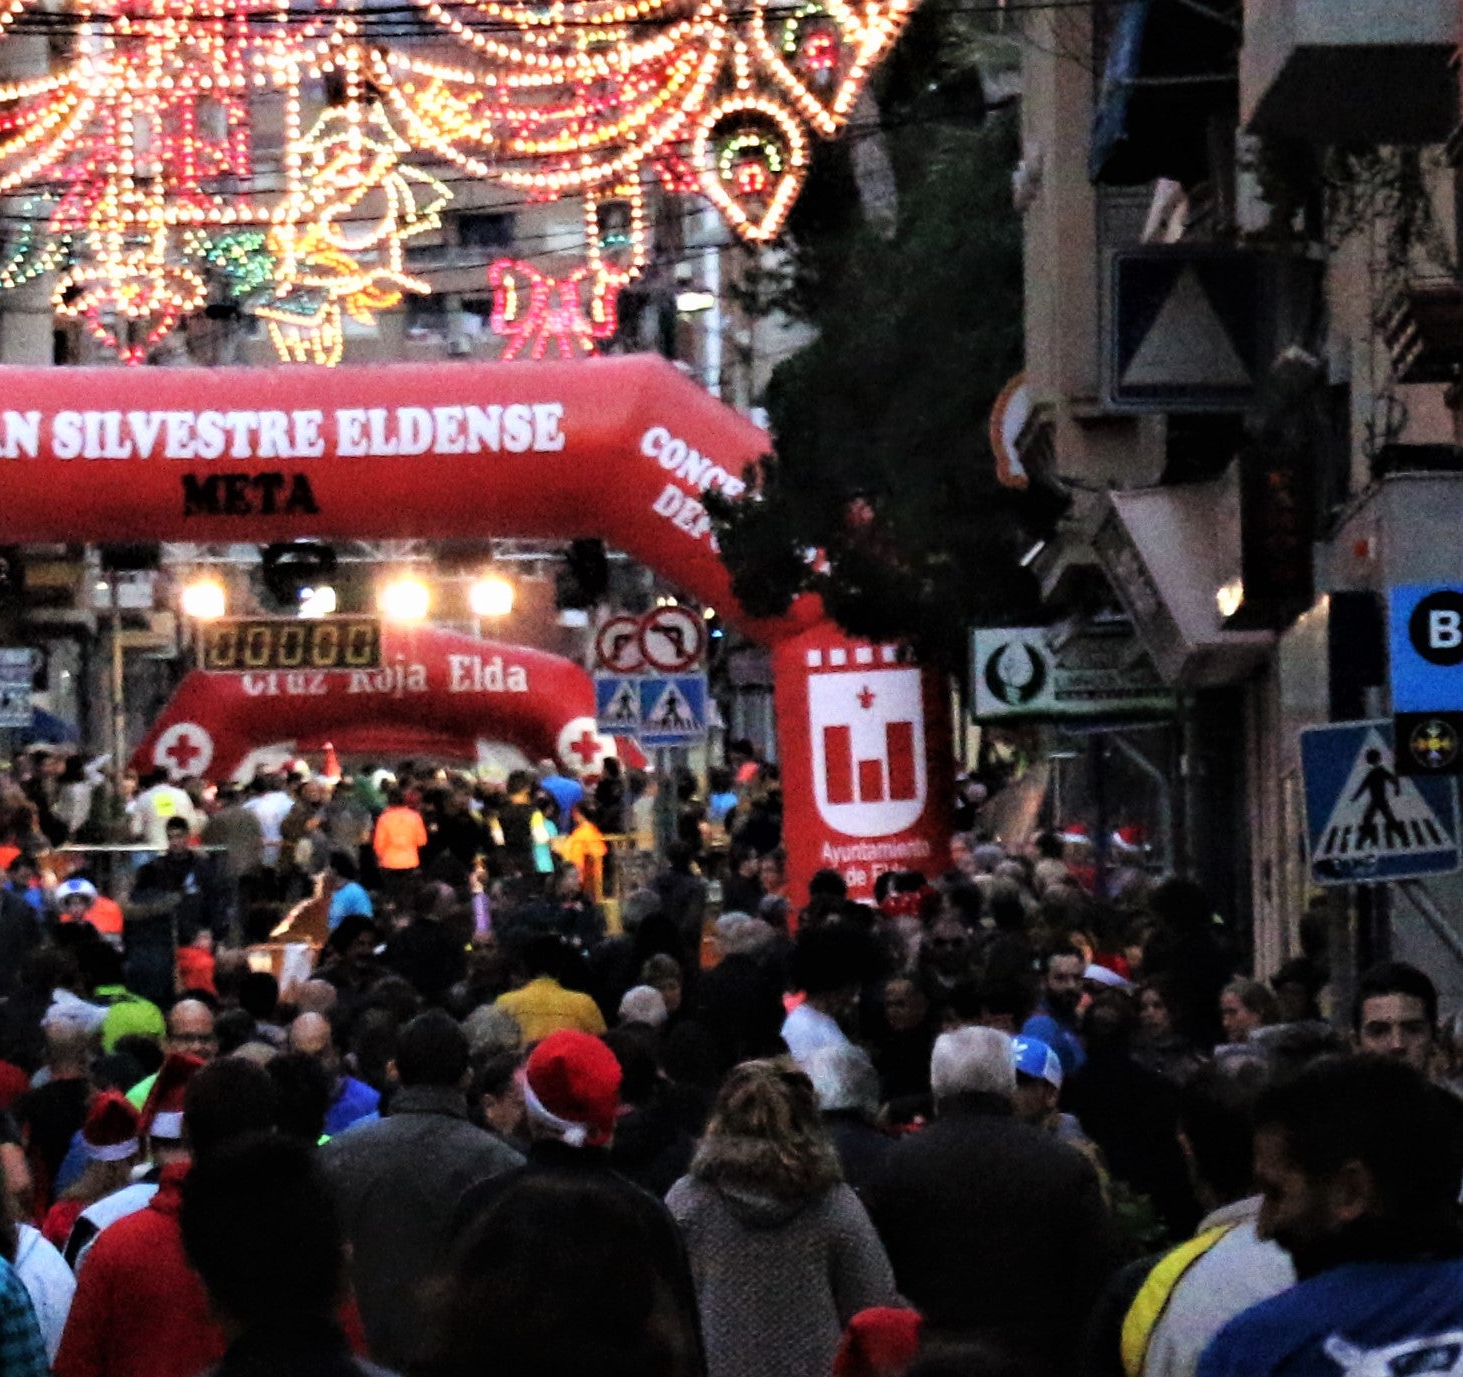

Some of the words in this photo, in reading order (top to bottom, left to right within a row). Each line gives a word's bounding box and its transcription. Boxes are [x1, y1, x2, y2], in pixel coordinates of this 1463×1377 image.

[52, 409, 326, 460] SILVESTRE
[335, 402, 566, 458] ELDENSE
[640, 426, 747, 499] CONCE
[183, 471, 321, 516] META
[1429, 609, 1463, 649] B
[448, 652, 530, 693] Elda
[822, 841, 930, 868] Ayuntamiento
[844, 866, 867, 888] de
